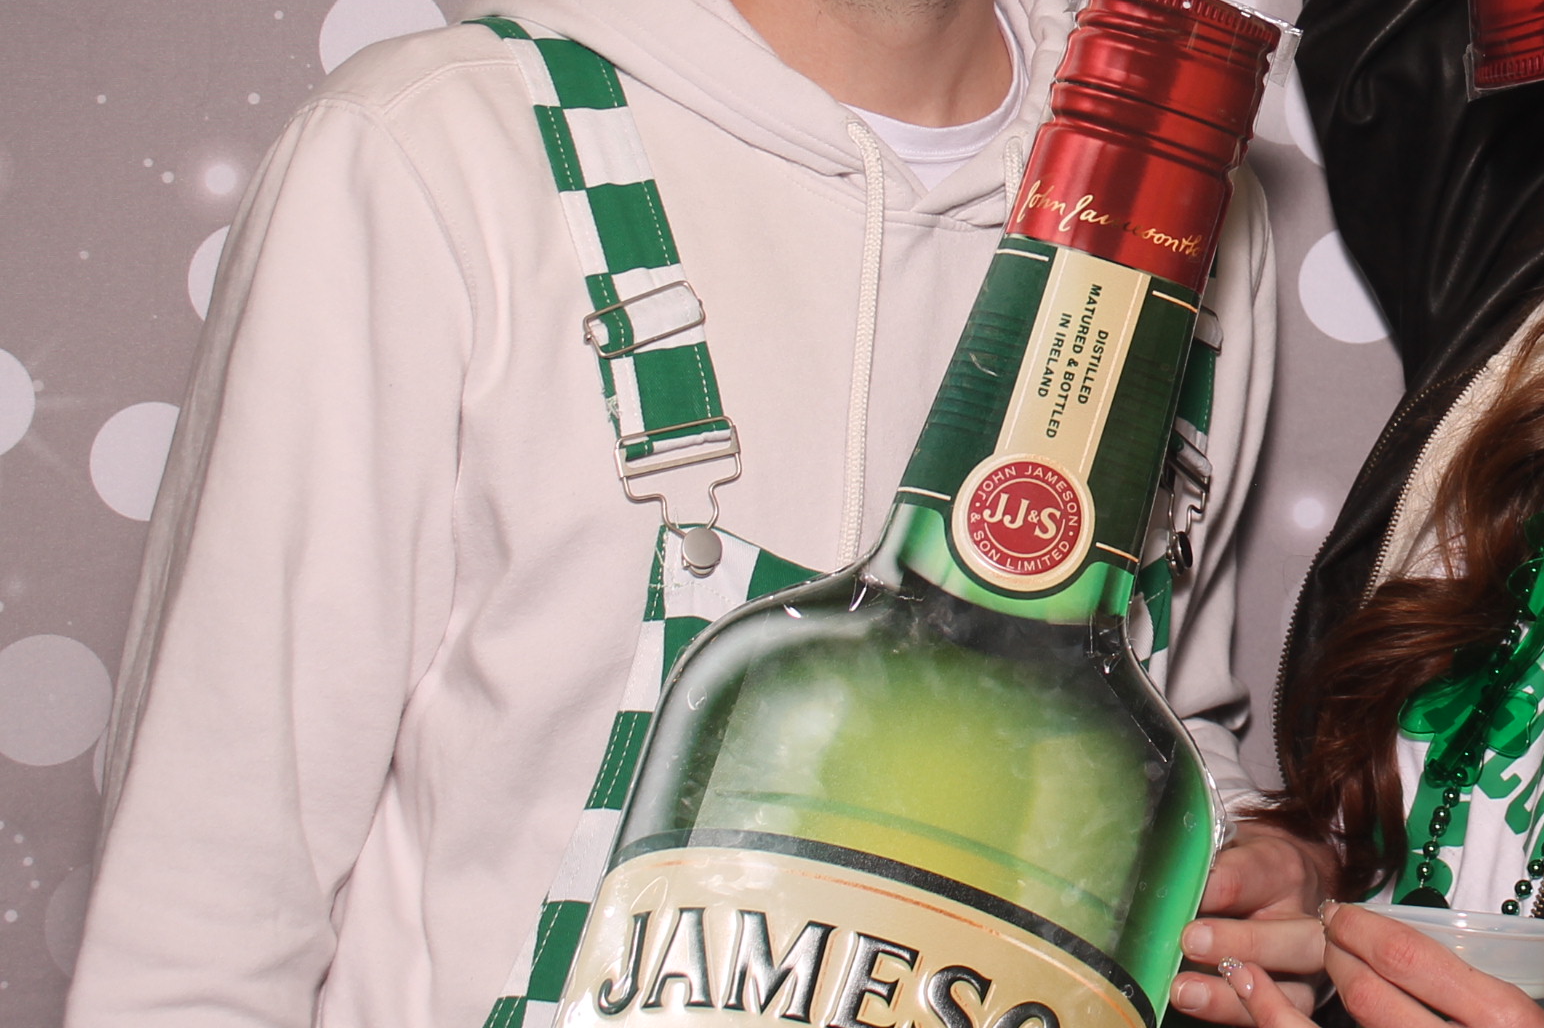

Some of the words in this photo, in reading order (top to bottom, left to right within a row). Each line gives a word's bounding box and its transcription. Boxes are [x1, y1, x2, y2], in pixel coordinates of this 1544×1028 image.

[1058, 312, 1073, 330] IN
[1071, 283, 1103, 355] MATURED
[1037, 331, 1067, 398] IRELAND
[1066, 357, 1079, 368] &
[1077, 329, 1109, 405] DISTILLED
[1045, 370, 1076, 439] BOTTLED
[977, 465, 1017, 501] JOHN
[1023, 464, 1079, 527] JAMESON
[982, 491, 1062, 540] JJ&S
[973, 530, 1001, 561] SON
[1005, 540, 1071, 572] LIMITED
[598, 906, 1061, 1028] JAMES
